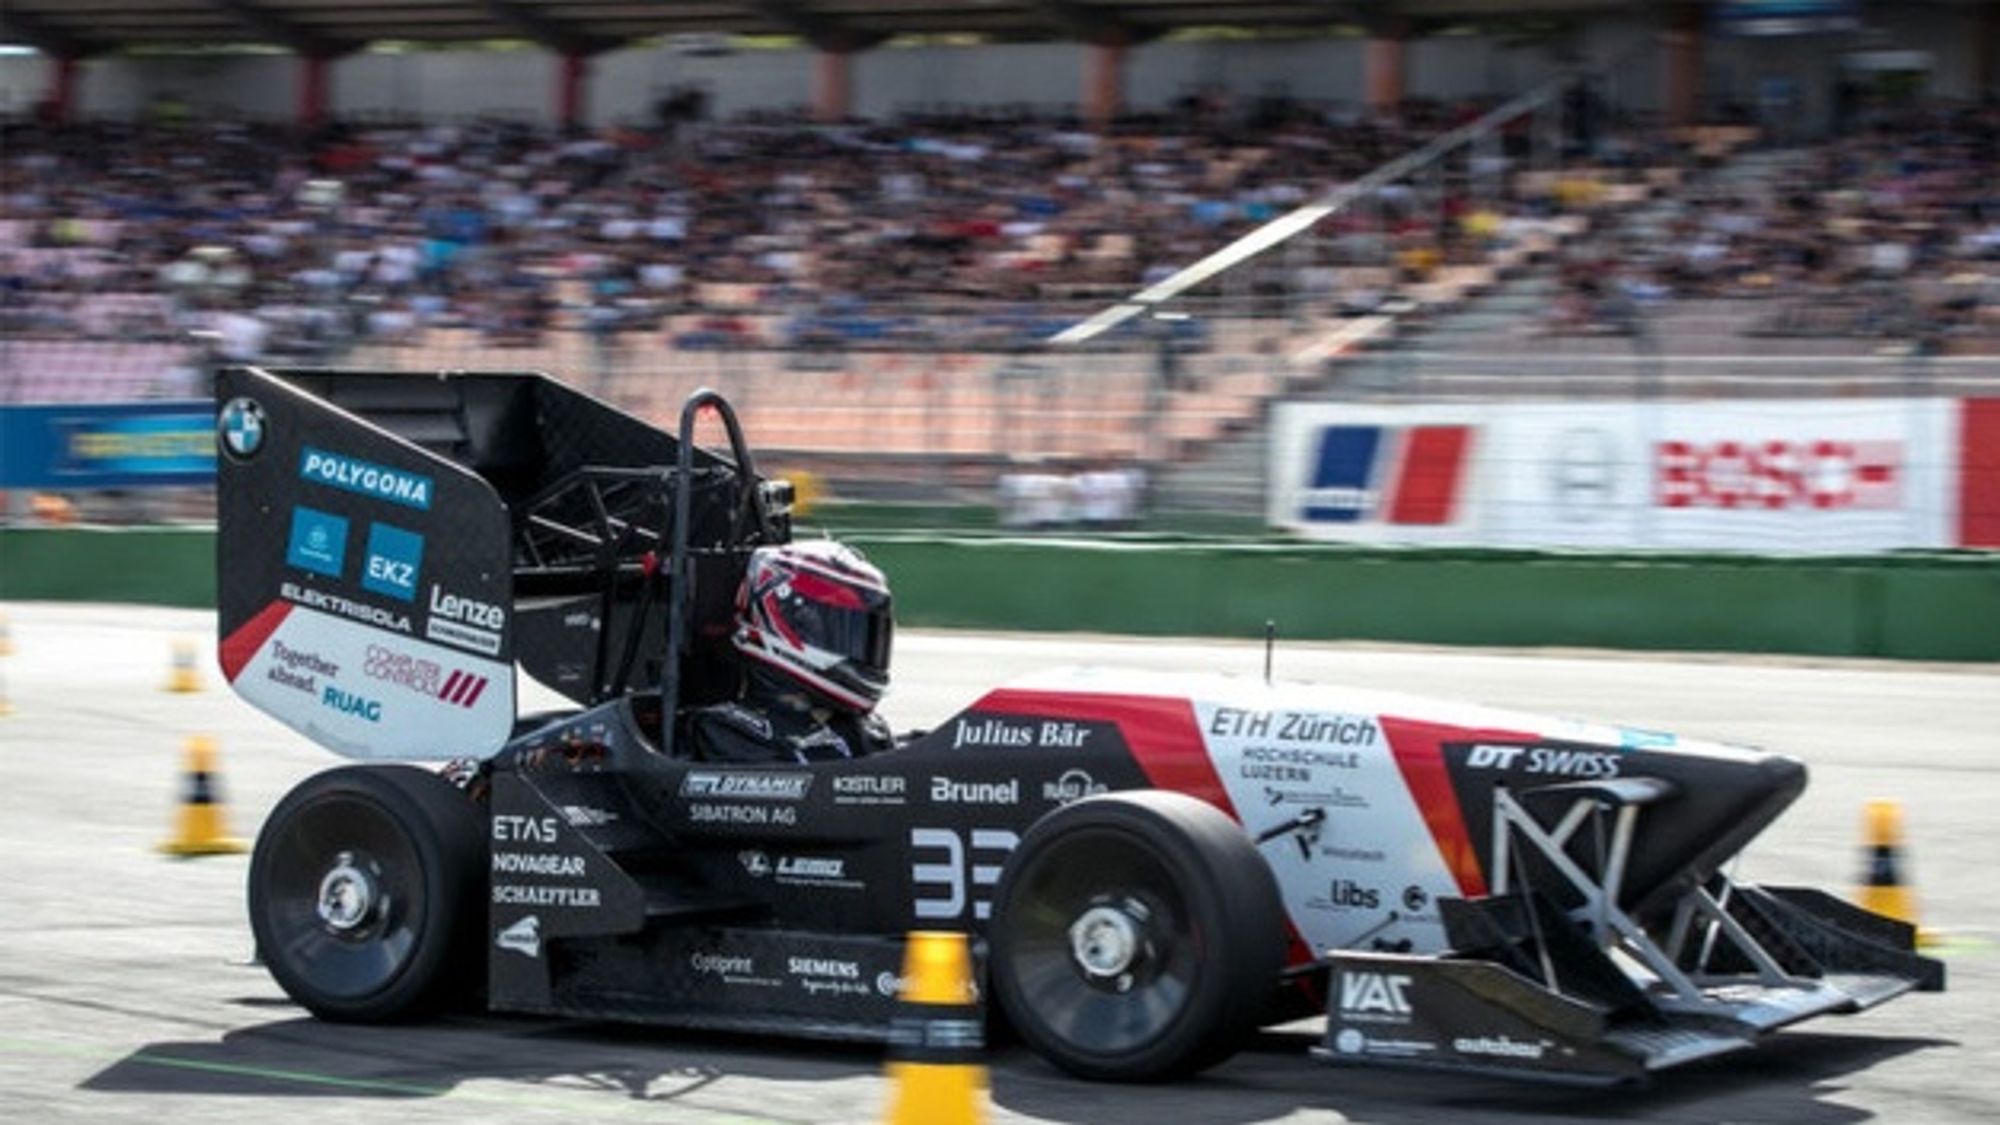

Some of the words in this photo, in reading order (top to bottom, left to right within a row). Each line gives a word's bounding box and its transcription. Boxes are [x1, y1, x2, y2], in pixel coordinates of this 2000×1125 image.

[305, 454, 428, 502] POLYGONA
[368, 554, 414, 588] EKZ
[280, 582, 412, 632] ELEKTRISOLA
[430, 584, 504, 629] Lenze
[271, 640, 340, 677] Together
[322, 686, 381, 722] RUAG
[953, 719, 1033, 750] Julius
[1038, 721, 1091, 748] Bär
[1211, 707, 1272, 738] ETH
[1278, 713, 1377, 746] Zürich
[1240, 764, 1312, 783] LUZERN
[1242, 748, 1360, 769] HOCHSCHULE
[1466, 744, 1524, 769] DT
[1525, 748, 1623, 778] SWISS
[931, 776, 1020, 804] Brunel
[493, 815, 558, 843] ETAS
[689, 804, 767, 824] SIBATRON
[772, 806, 797, 825] AG
[493, 853, 586, 876] NOVAGEAR
[492, 885, 602, 907] SCHAEFFLER
[788, 956, 860, 980] SIEMENS
